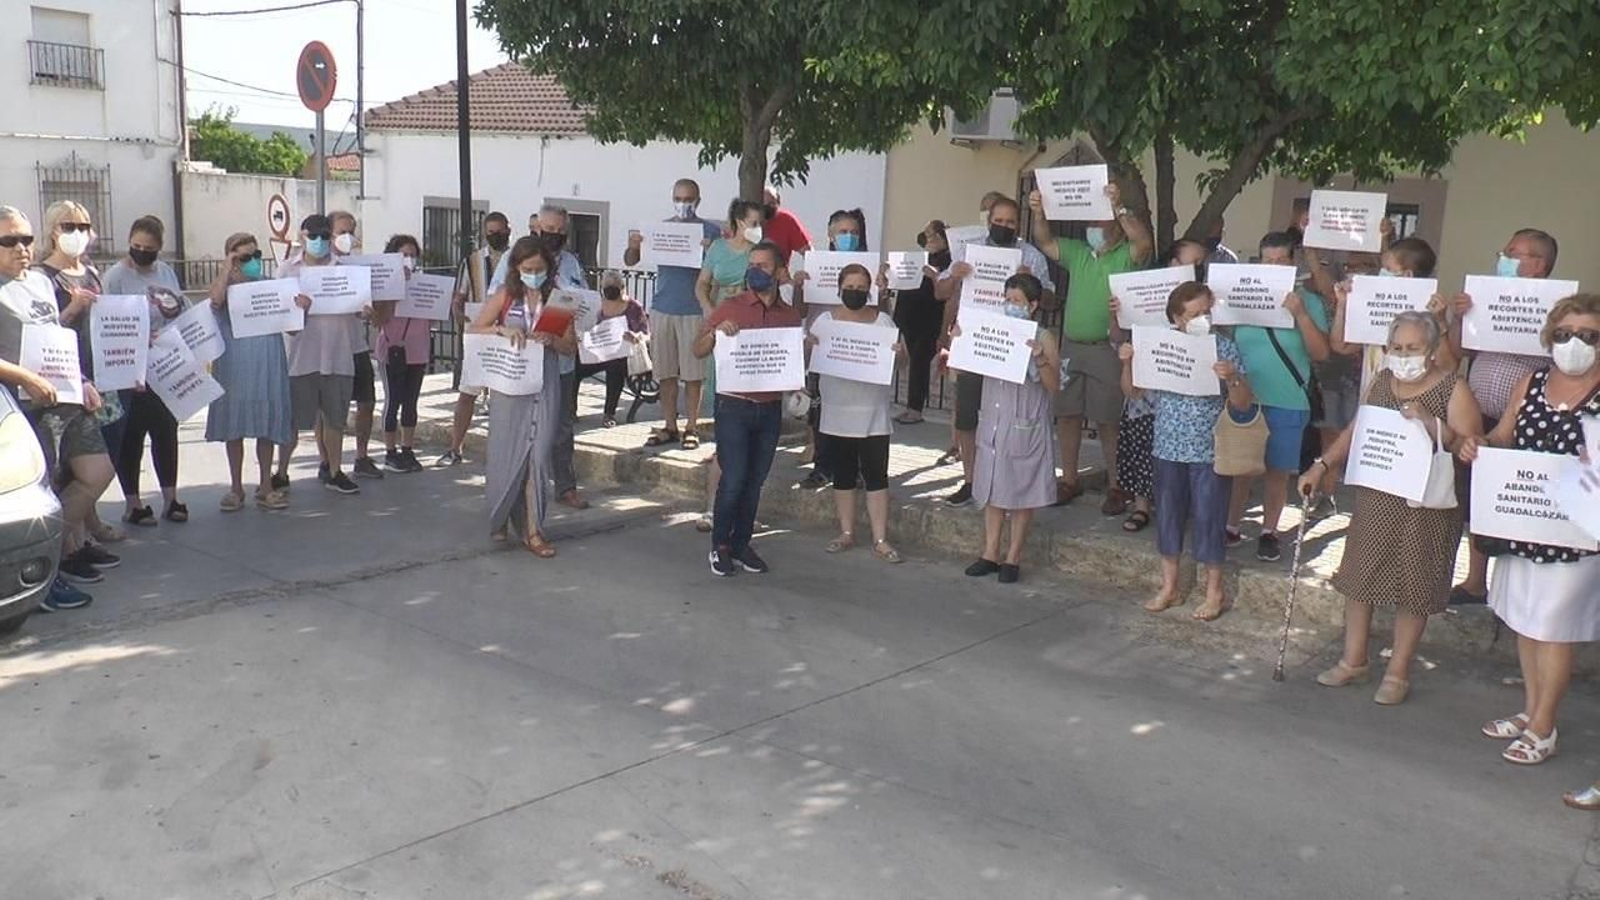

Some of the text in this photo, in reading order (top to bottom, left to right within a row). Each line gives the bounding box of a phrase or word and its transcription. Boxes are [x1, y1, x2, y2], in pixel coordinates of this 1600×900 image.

[1239, 277, 1251, 285] NO
[1375, 292, 1386, 300] NO
[1499, 294, 1511, 303] NO
[1522, 296, 1539, 304] LOS
[1488, 304, 1547, 315] RECORTES EN
[1491, 314, 1542, 325] ASISTENCIA
[981, 325, 990, 334] NO
[997, 329, 1010, 337] LOS
[1493, 324, 1538, 335] SANITARIA
[973, 332, 1005, 345] RECORTES
[1516, 469, 1550, 482] NO AL
[1496, 493, 1552, 507] SANITARIO
